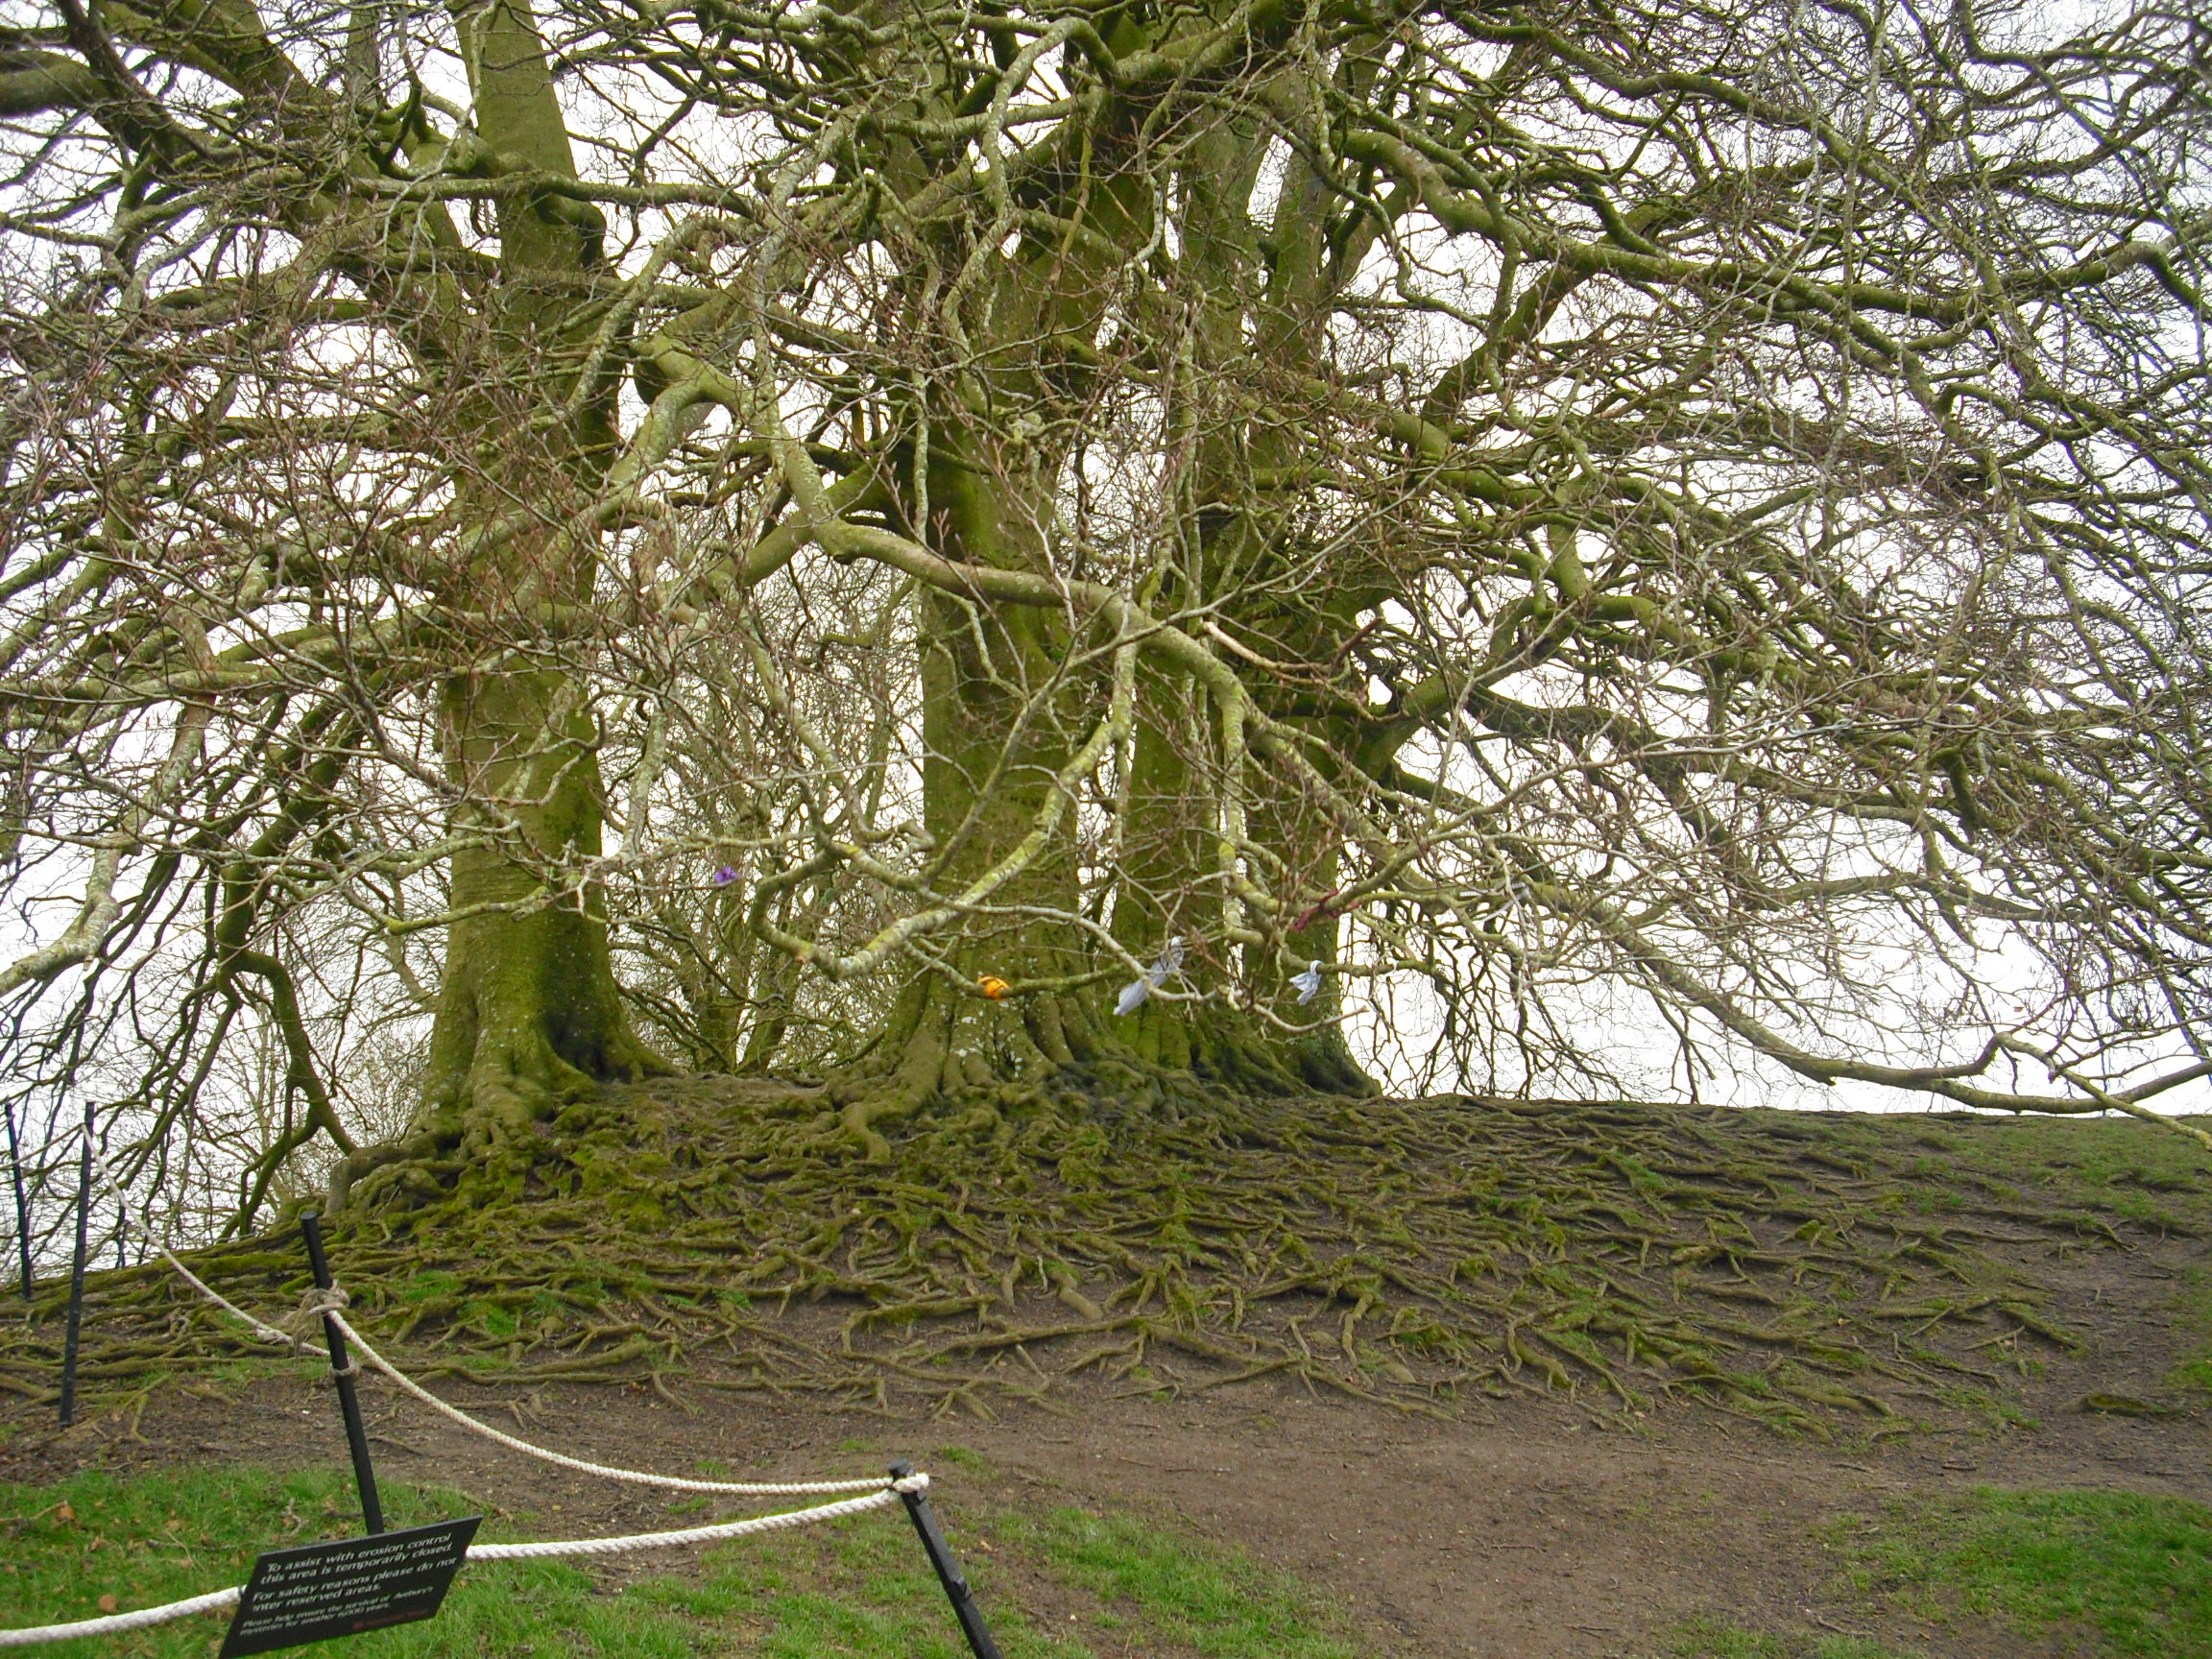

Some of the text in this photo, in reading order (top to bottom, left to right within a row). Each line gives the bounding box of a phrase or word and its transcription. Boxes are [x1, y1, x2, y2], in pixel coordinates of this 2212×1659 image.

[261, 1543, 453, 1584] this area is temporarily closed.
[268, 1532, 452, 1573] To assist with erosion control
[252, 1557, 457, 1602] For safety reasons please do not
[286, 1589, 343, 1606] reserved
[242, 1617, 273, 1628] Please
